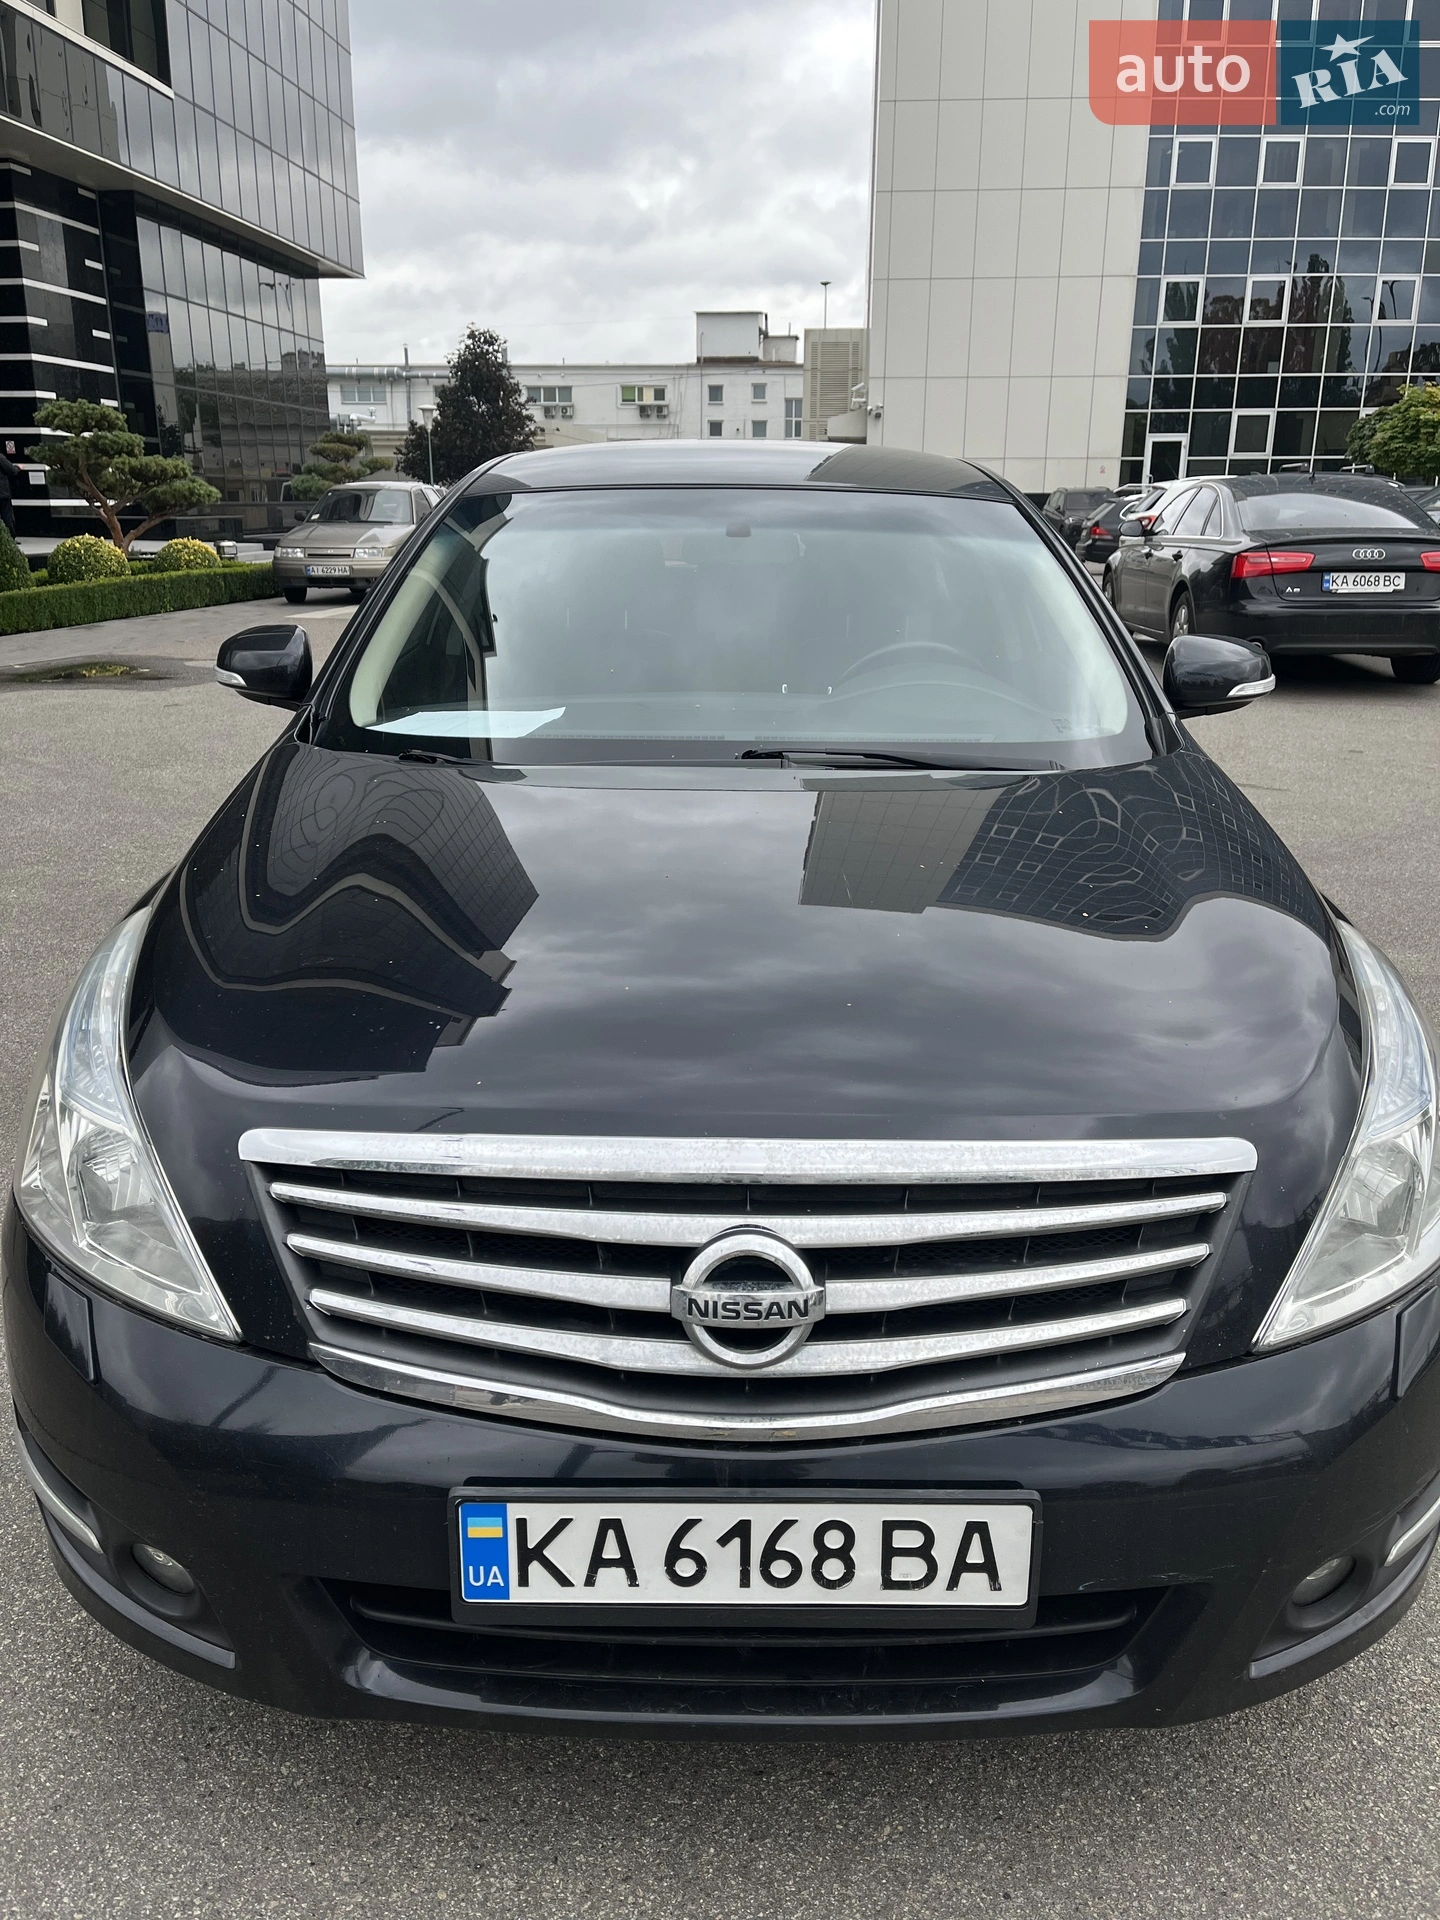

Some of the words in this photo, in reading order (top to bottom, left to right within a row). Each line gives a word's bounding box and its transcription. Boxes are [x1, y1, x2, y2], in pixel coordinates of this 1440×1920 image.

[321, 566, 337, 574] 6229
[338, 566, 348, 574] HA
[1331, 575, 1349, 587] KA
[1352, 575, 1381, 587] 6068
[1383, 575, 1401, 587] BC
[687, 1298, 809, 1321] NISSAN
[515, 1517, 640, 1588] KA
[664, 1518, 856, 1590] 6168
[880, 1519, 1003, 1591] BA
[468, 1565, 505, 1587] UA
